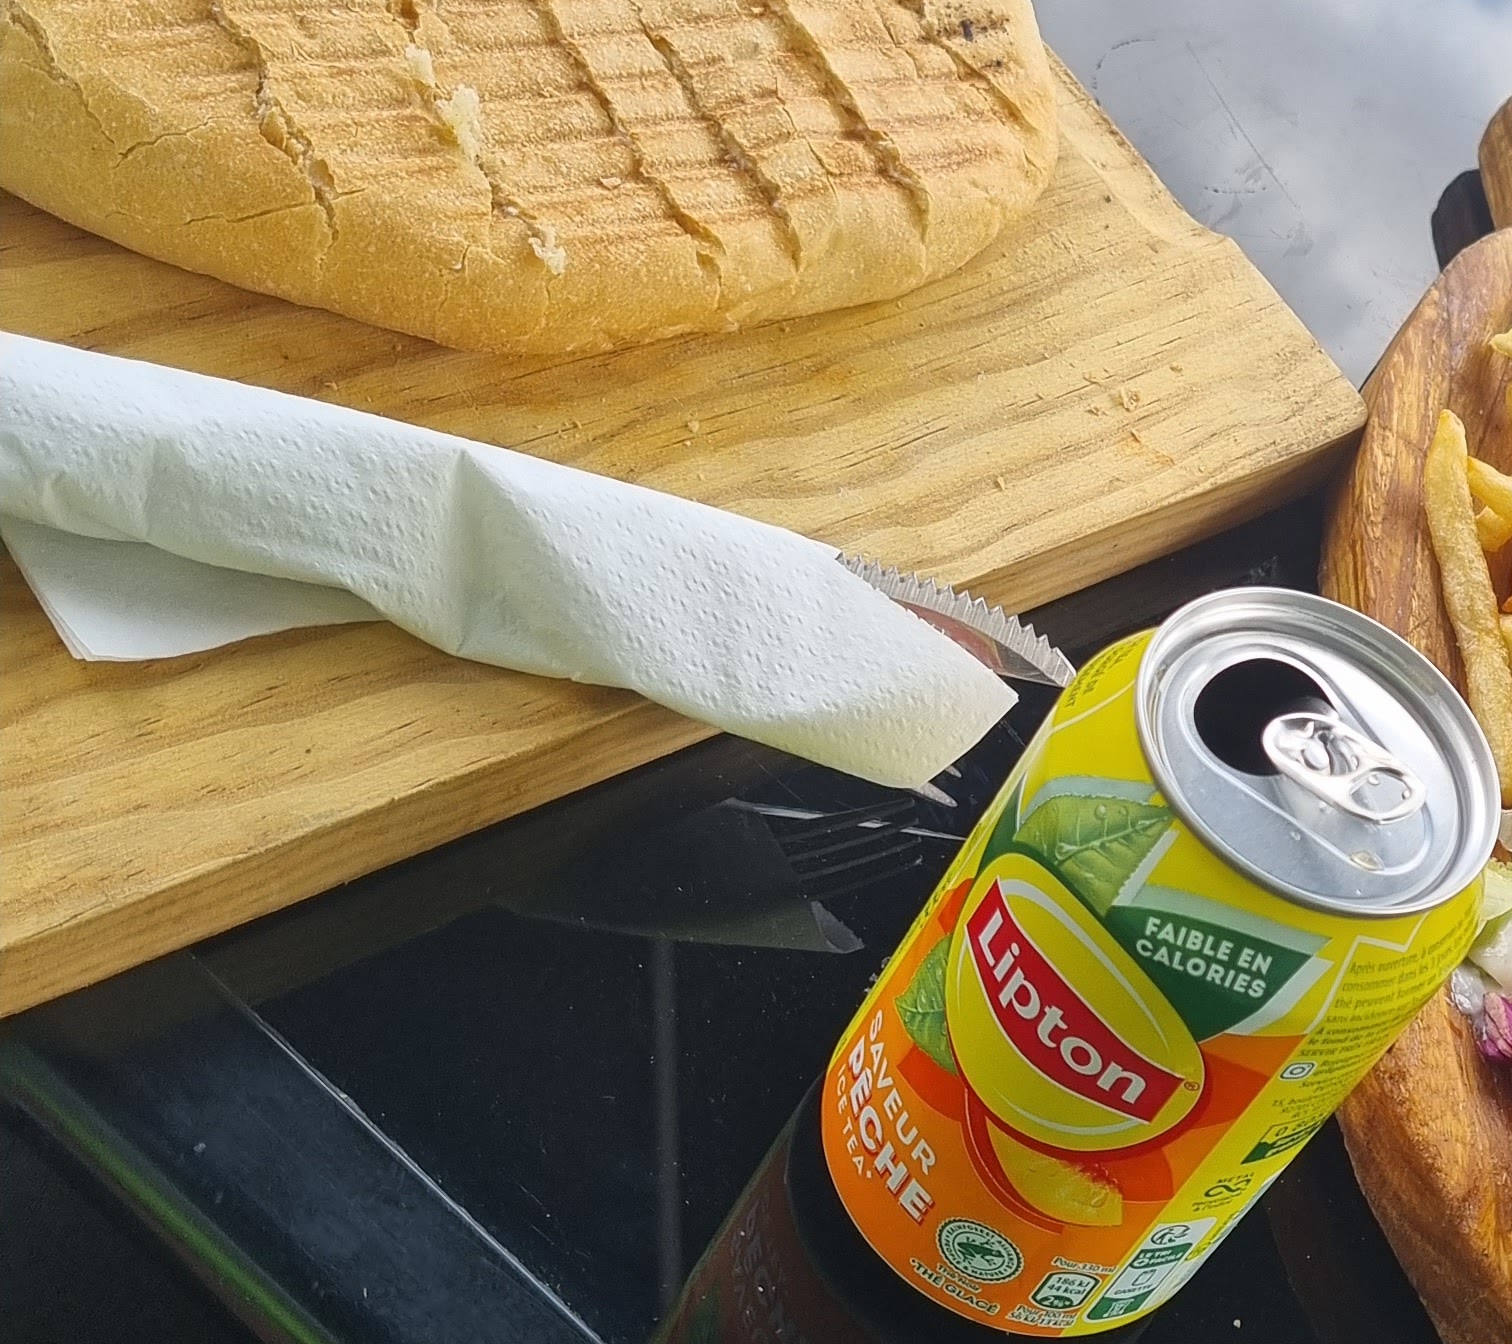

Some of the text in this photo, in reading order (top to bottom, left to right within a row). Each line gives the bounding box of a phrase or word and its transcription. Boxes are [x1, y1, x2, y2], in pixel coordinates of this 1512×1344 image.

[1135, 939, 1267, 998] CALORIES
[1144, 916, 1273, 976] FAIBLE EN
[978, 908, 1146, 1104] Lipton
[837, 1064, 848, 1115] ICE
[869, 1009, 936, 1176] SAVEUR
[848, 1034, 935, 1225] PÊCHE
[945, 1283, 998, 1314] GLACÉ
[1047, 1284, 1086, 1295] 44 kcal
[1056, 1277, 1077, 1286] 186
